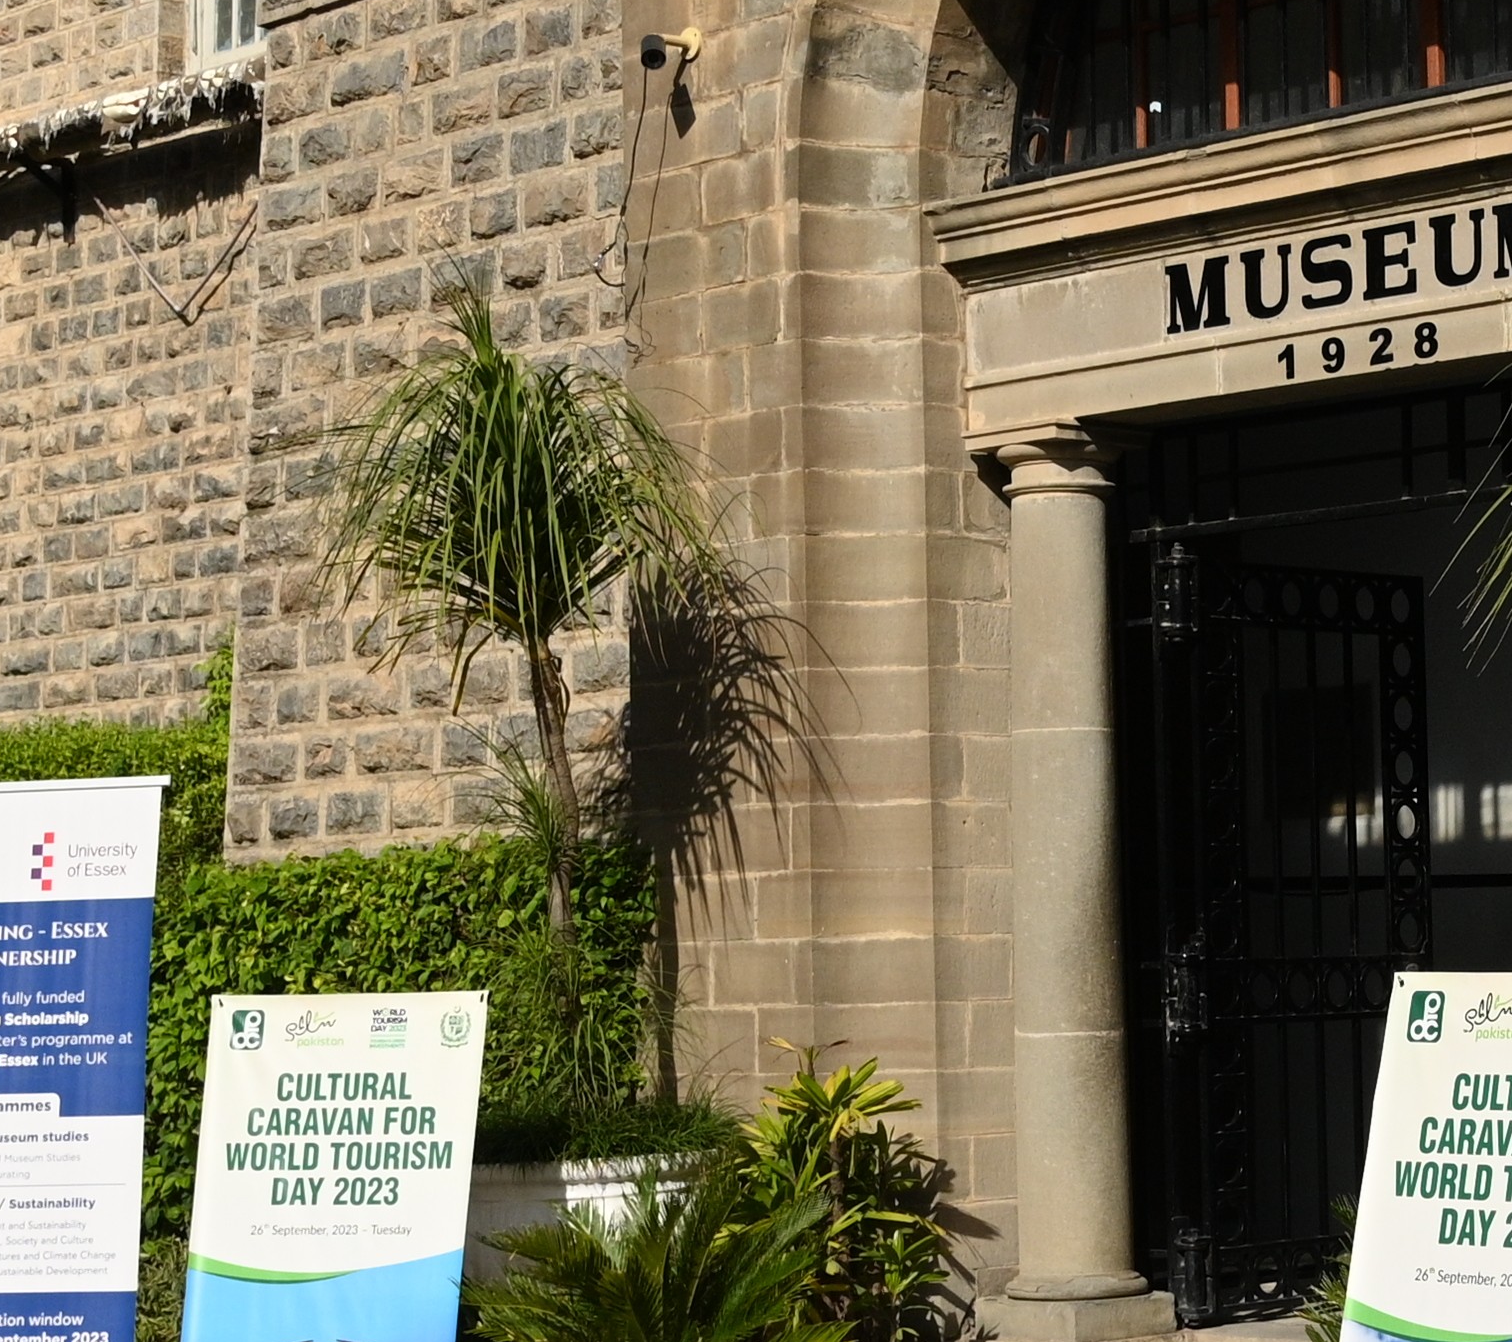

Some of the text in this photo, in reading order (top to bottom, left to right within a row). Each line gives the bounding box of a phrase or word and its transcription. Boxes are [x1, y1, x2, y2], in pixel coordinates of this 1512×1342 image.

[1277, 322, 1439, 380] 1928
[68, 843, 138, 858] University
[67, 863, 127, 878] of Essex
[51, 922, 108, 939] ESSEX
[2, 991, 32, 1007] fully
[37, 990, 85, 1004] funded
[4, 1011, 89, 1026] Scholarship
[373, 1008, 406, 1016] WORLD
[31, 1033, 114, 1048] programme
[119, 1031, 132, 1044] at
[297, 1036, 344, 1049] pakistan
[42, 1053, 54, 1066] in
[59, 1052, 82, 1066] the
[86, 1052, 107, 1065] UK
[277, 1073, 412, 1101] CULTURAL
[247, 1106, 436, 1136] CARAVAN FOR
[43, 1131, 89, 1142] studies
[5, 1153, 43, 1162] Museum
[47, 1153, 80, 1162] Studies
[226, 1141, 453, 1171] WORLD TOURISM
[1396, 1160, 1493, 1201] WORLD
[271, 1177, 399, 1206] DAY 2023
[9, 1198, 96, 1210] Sustainability
[8, 1221, 25, 1230] and
[28, 1220, 86, 1231] Sustainability
[272, 1225, 329, 1237] September,
[332, 1225, 358, 1235] 2023
[372, 1225, 411, 1236] Tuesday
[1438, 1208, 1497, 1247] DAY
[5, 1236, 37, 1247] Society
[41, 1236, 57, 1245] and
[60, 1235, 93, 1244] Culture
[24, 1252, 40, 1260] and
[43, 1251, 77, 1260] Climate
[80, 1250, 116, 1260] Change
[46, 1266, 107, 1276] Development
[1415, 1267, 1435, 1282] 26th
[1438, 1269, 1497, 1287] September,
[29, 1312, 83, 1326] window
